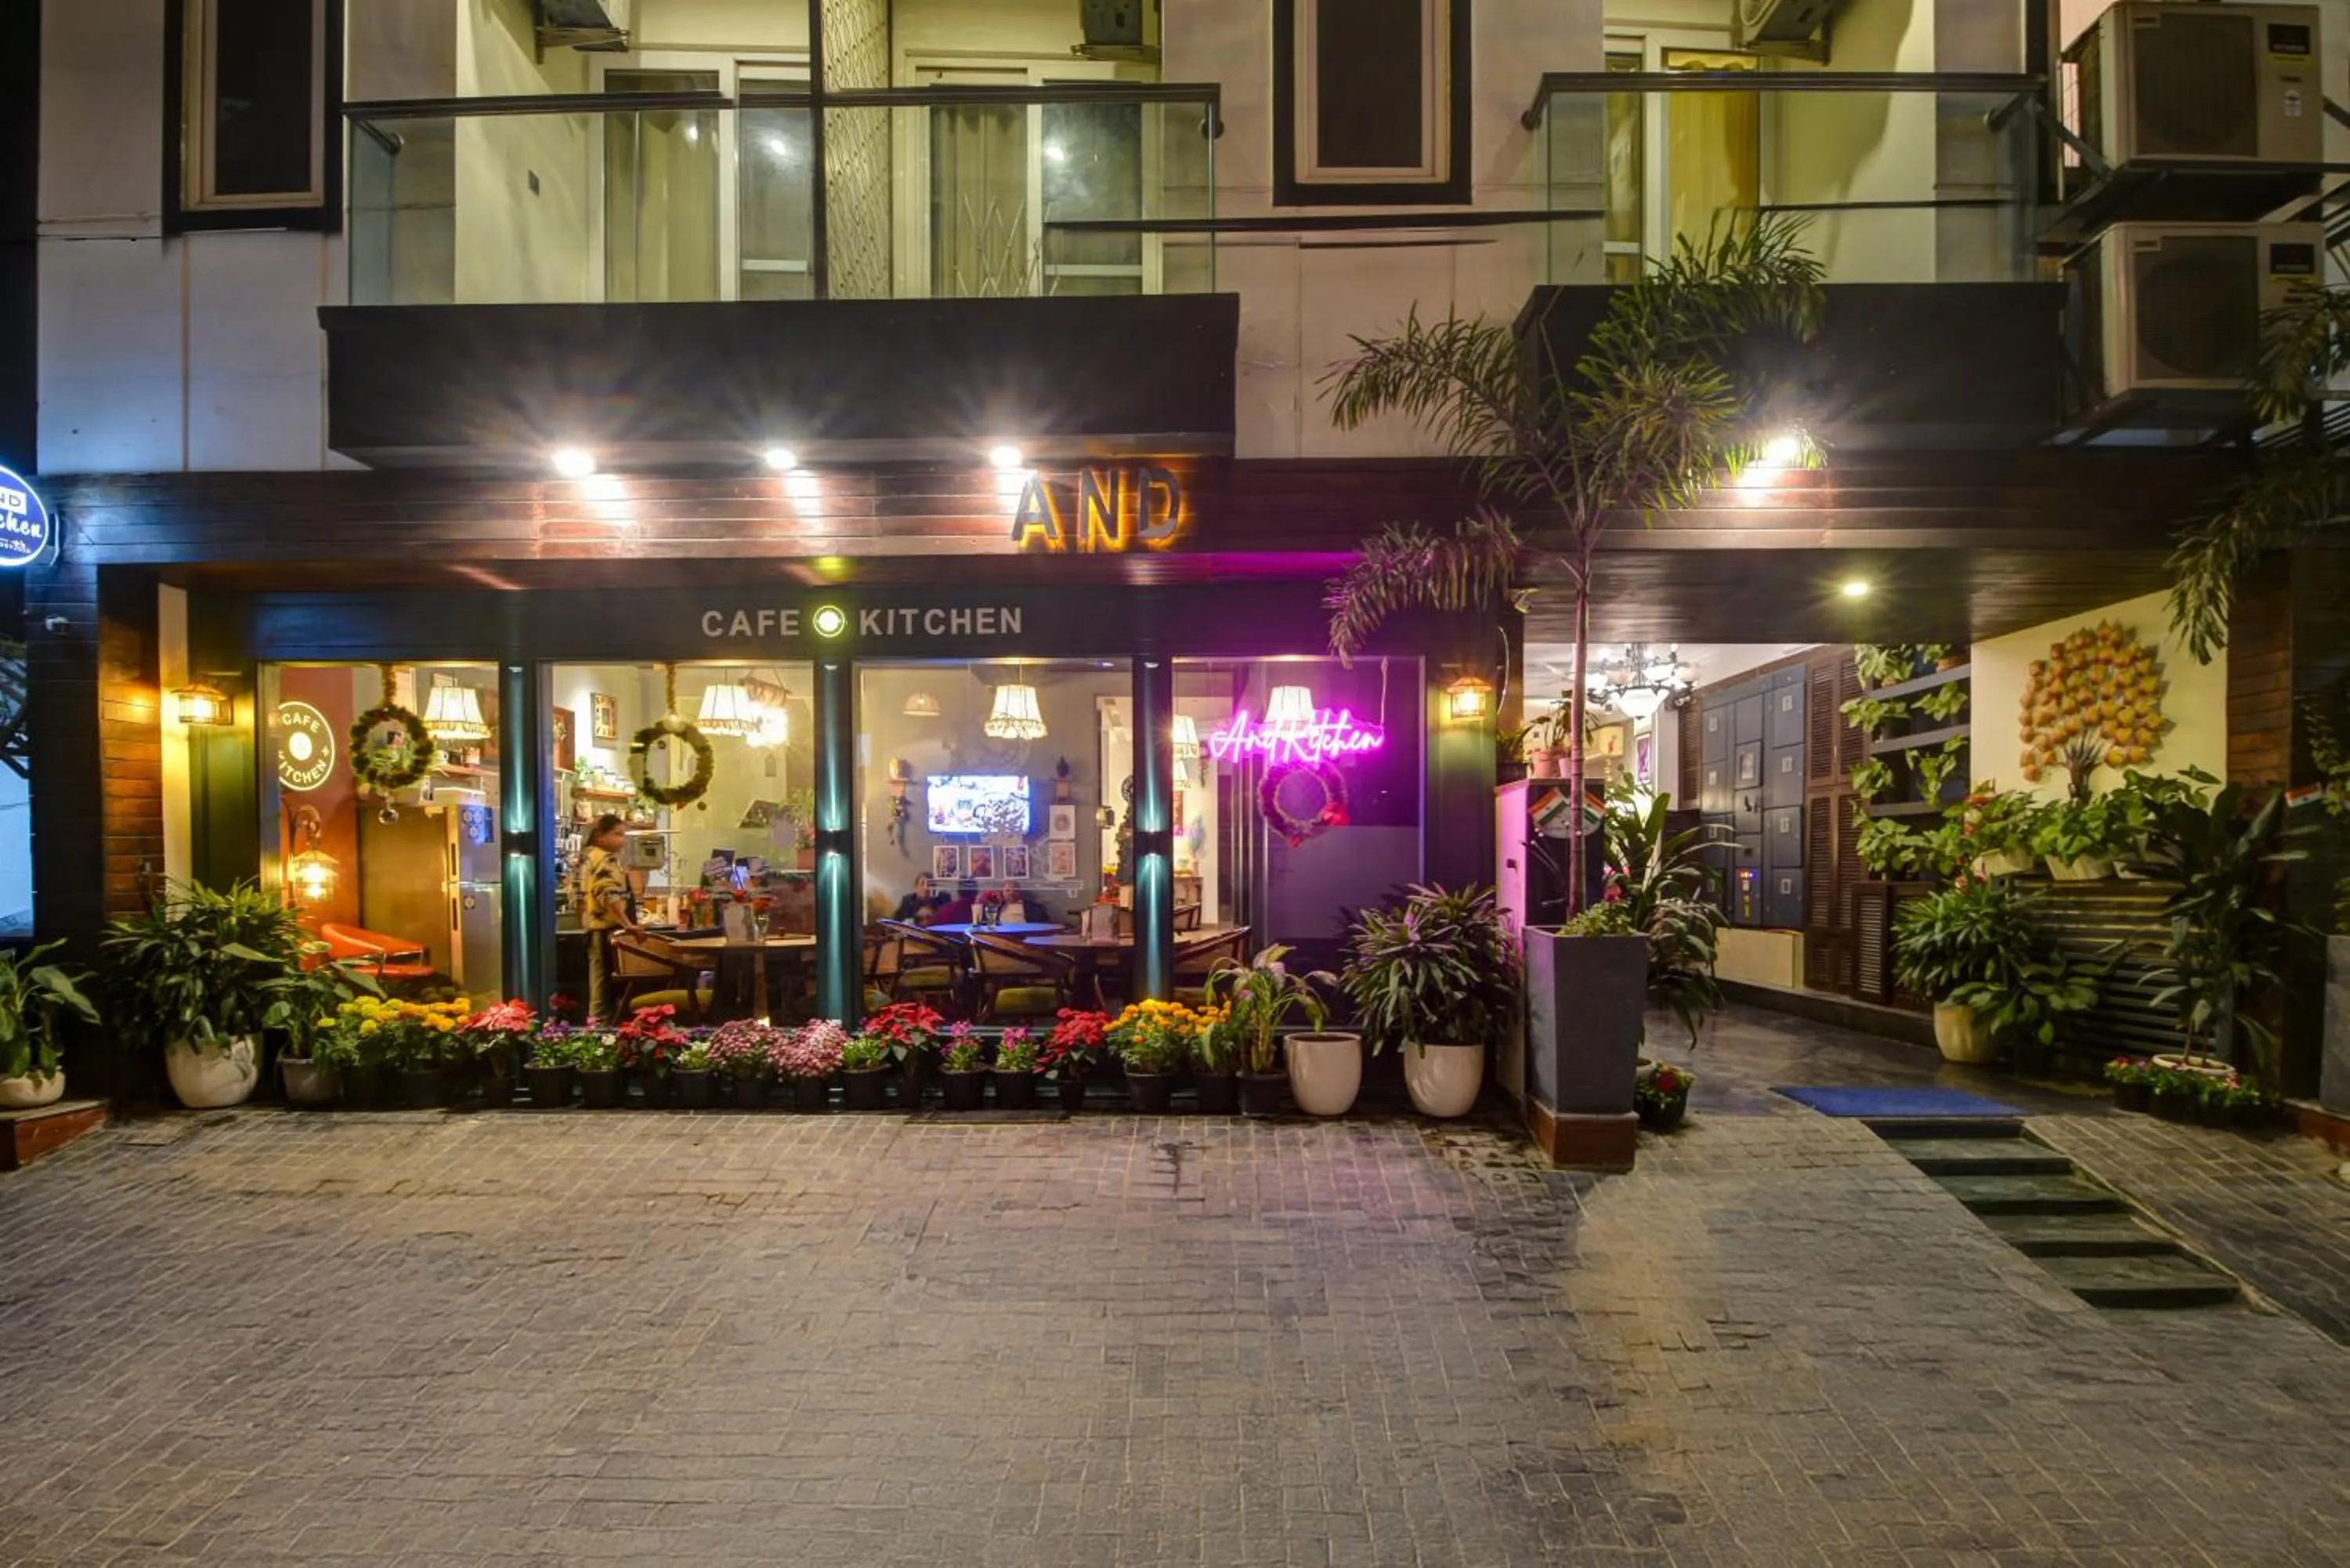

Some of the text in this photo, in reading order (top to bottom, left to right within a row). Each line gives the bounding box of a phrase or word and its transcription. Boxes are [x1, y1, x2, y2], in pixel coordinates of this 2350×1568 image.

[1011, 467, 1180, 541] AND
[702, 607, 1022, 637] CAFE KITCHEN
[282, 712, 320, 733] CAFE
